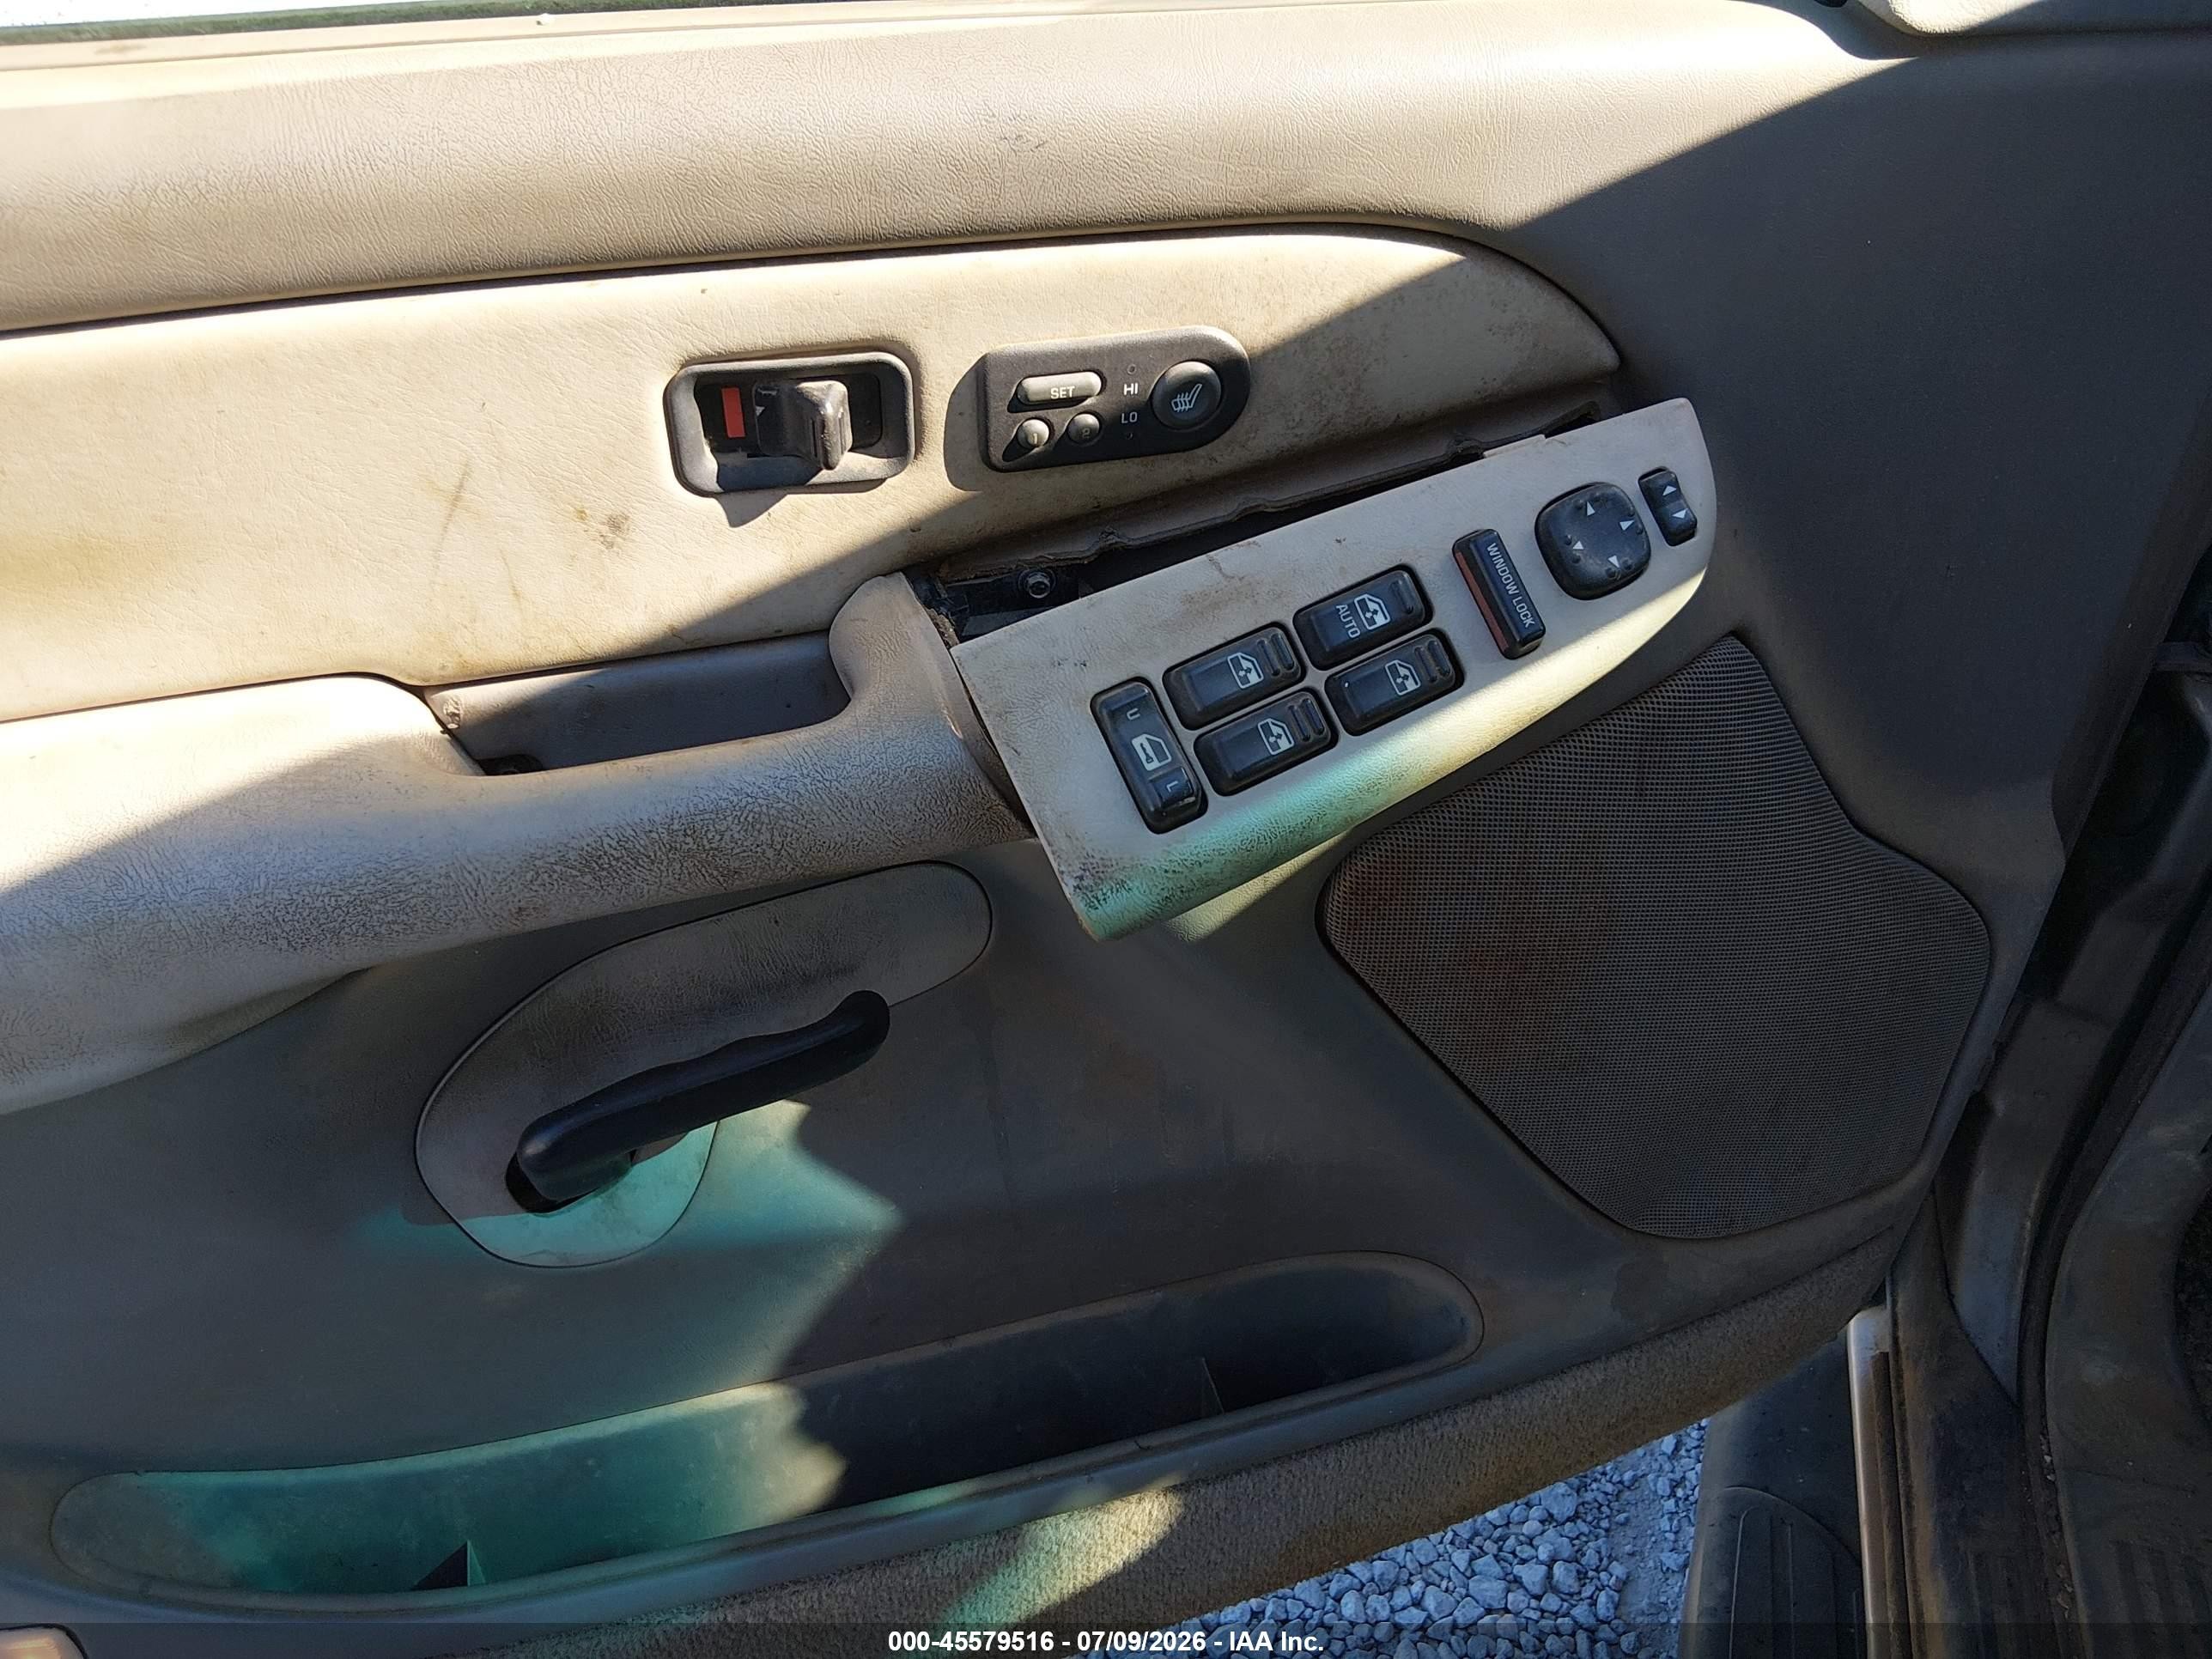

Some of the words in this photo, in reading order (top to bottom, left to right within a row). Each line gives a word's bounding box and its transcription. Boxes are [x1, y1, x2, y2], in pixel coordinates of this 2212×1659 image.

[1050, 386, 1075, 400] SET
[1123, 383, 1139, 396] HI
[1121, 411, 1139, 424] LO
[1031, 433, 1038, 445] 1
[1486, 542, 1520, 595] WINDOW
[1512, 596, 1535, 629] LOCK
[1335, 604, 1361, 639] AUTO
[1166, 781, 1179, 793] L
